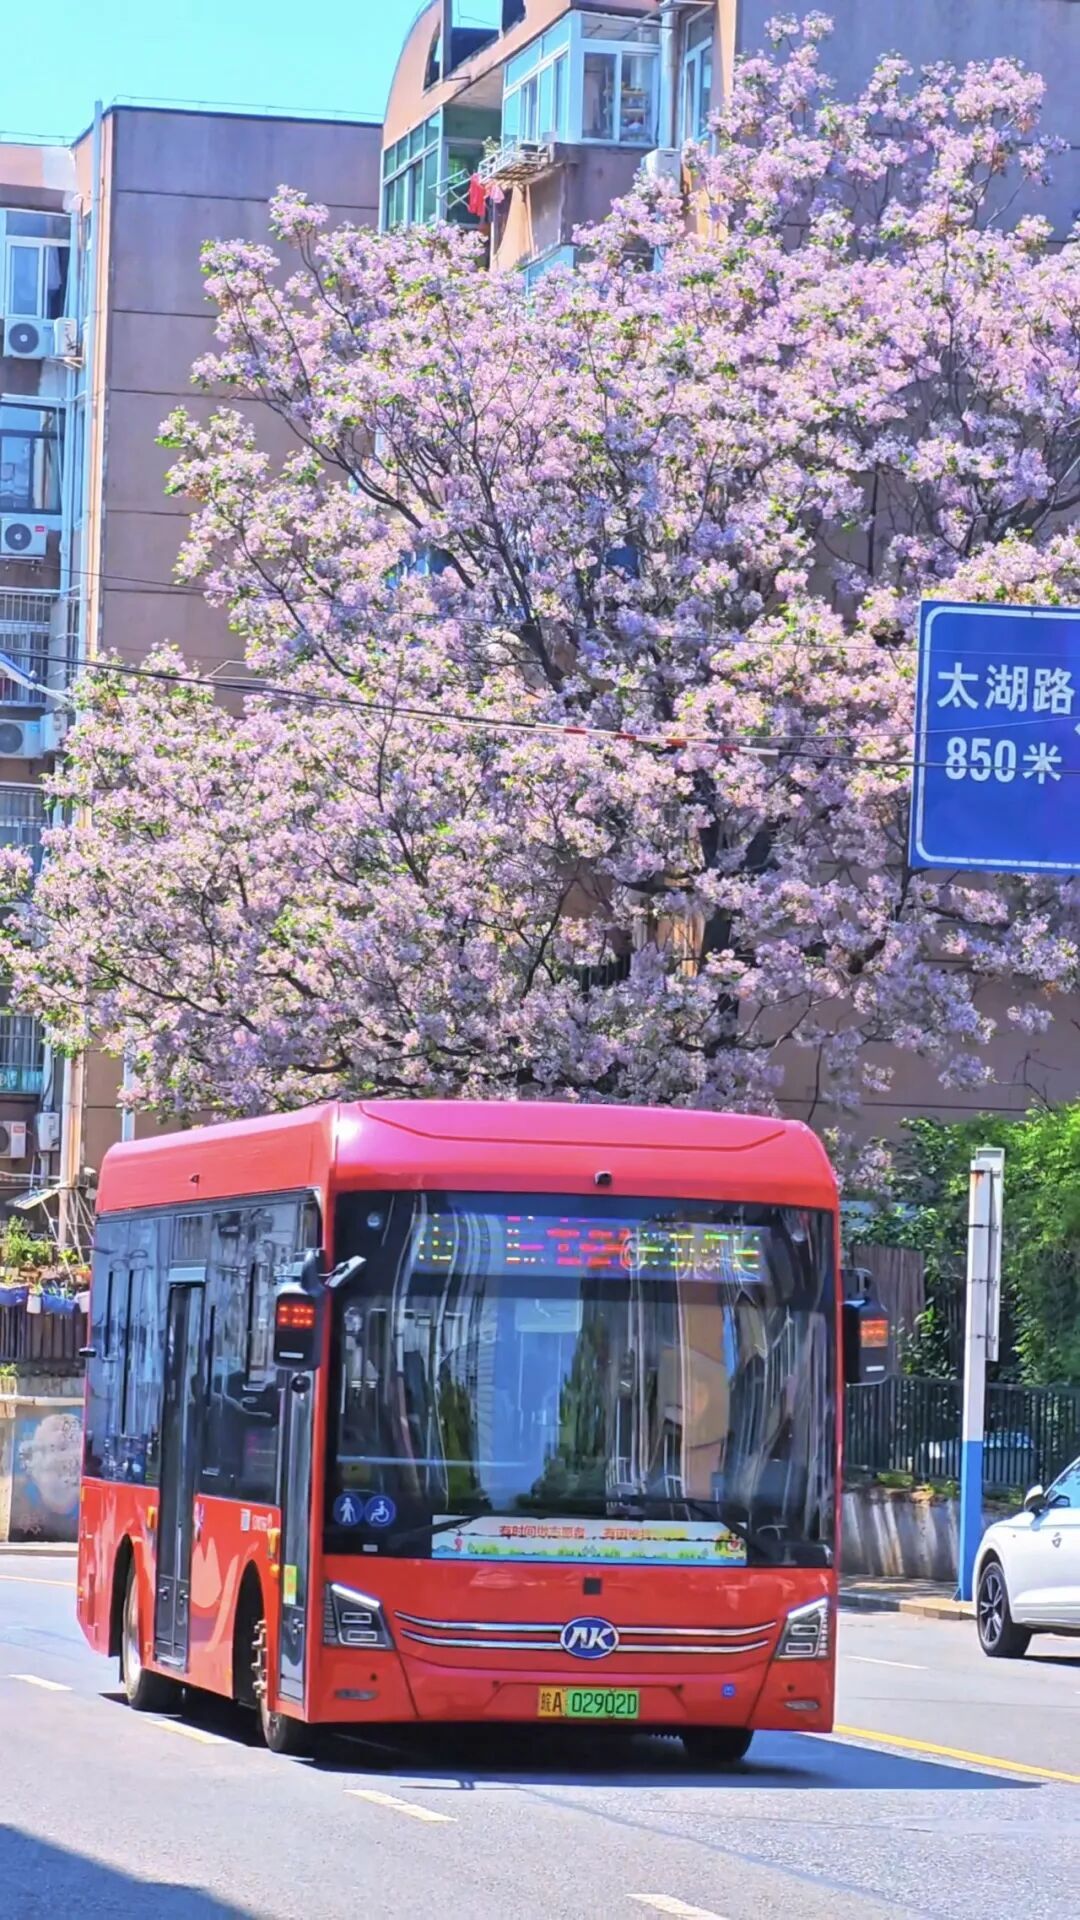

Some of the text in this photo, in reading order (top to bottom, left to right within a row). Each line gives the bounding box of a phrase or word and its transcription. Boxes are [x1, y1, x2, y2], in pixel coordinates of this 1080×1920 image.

[937, 662, 1076, 715] 太湖路
[945, 736, 1063, 785] 850米
[571, 1692, 637, 1715] 02902D
